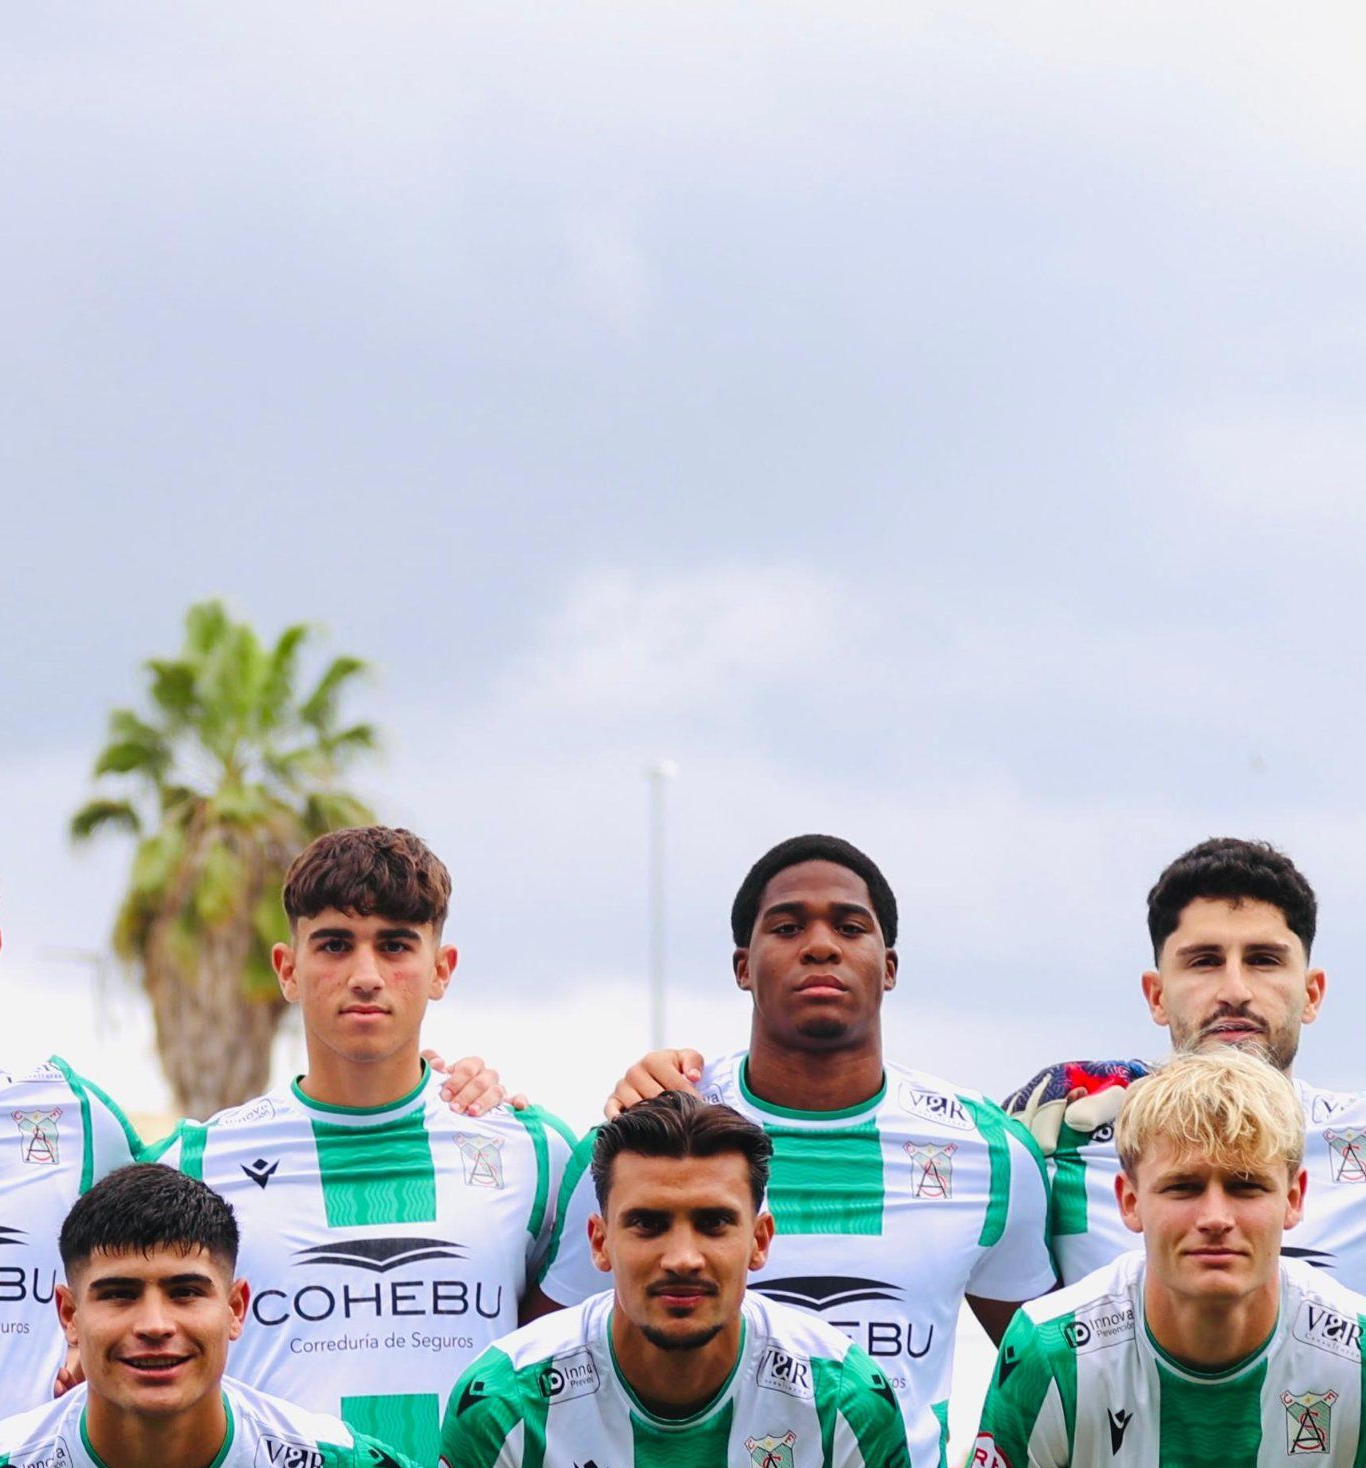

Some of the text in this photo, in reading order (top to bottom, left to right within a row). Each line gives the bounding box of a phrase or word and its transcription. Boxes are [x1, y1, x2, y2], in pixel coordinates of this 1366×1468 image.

[251, 1281, 502, 1326] COHEBU
[1088, 1309, 1135, 1331] Innova
[290, 1331, 474, 1355] Correduría de Seguros
[1308, 1305, 1364, 1352] V&R
